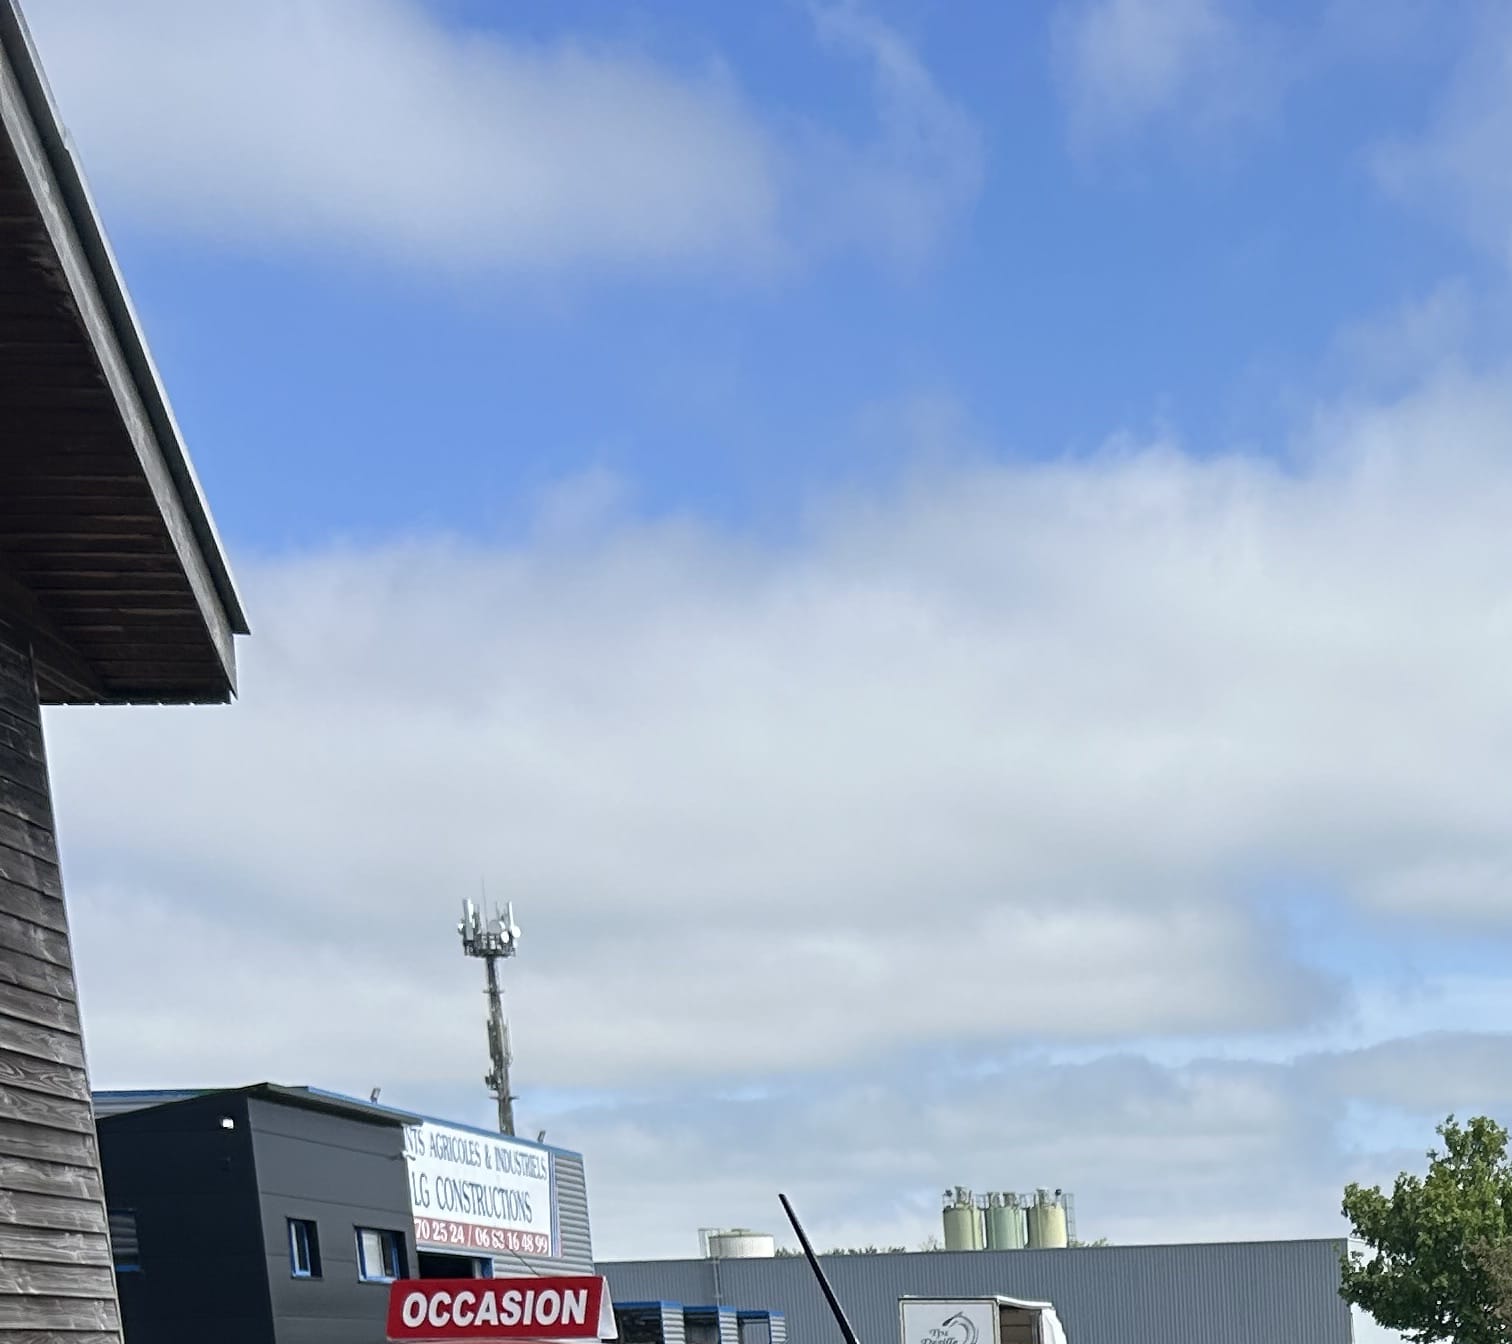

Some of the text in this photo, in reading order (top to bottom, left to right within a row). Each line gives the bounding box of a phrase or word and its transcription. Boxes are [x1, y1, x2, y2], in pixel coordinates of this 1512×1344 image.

[430, 1131, 481, 1168] AGRICOLES
[484, 1143, 493, 1170] &
[494, 1146, 548, 1181] INDUSTRIELS
[411, 1171, 533, 1224] LG CONSTRUCTIONS
[414, 1219, 430, 1240] 70
[432, 1221, 448, 1242] 25
[449, 1224, 465, 1245] 24
[475, 1227, 490, 1249] 06
[507, 1231, 520, 1251] 16
[521, 1233, 534, 1253] 48
[534, 1235, 548, 1254] 99
[402, 1289, 588, 1328] OCCASION
